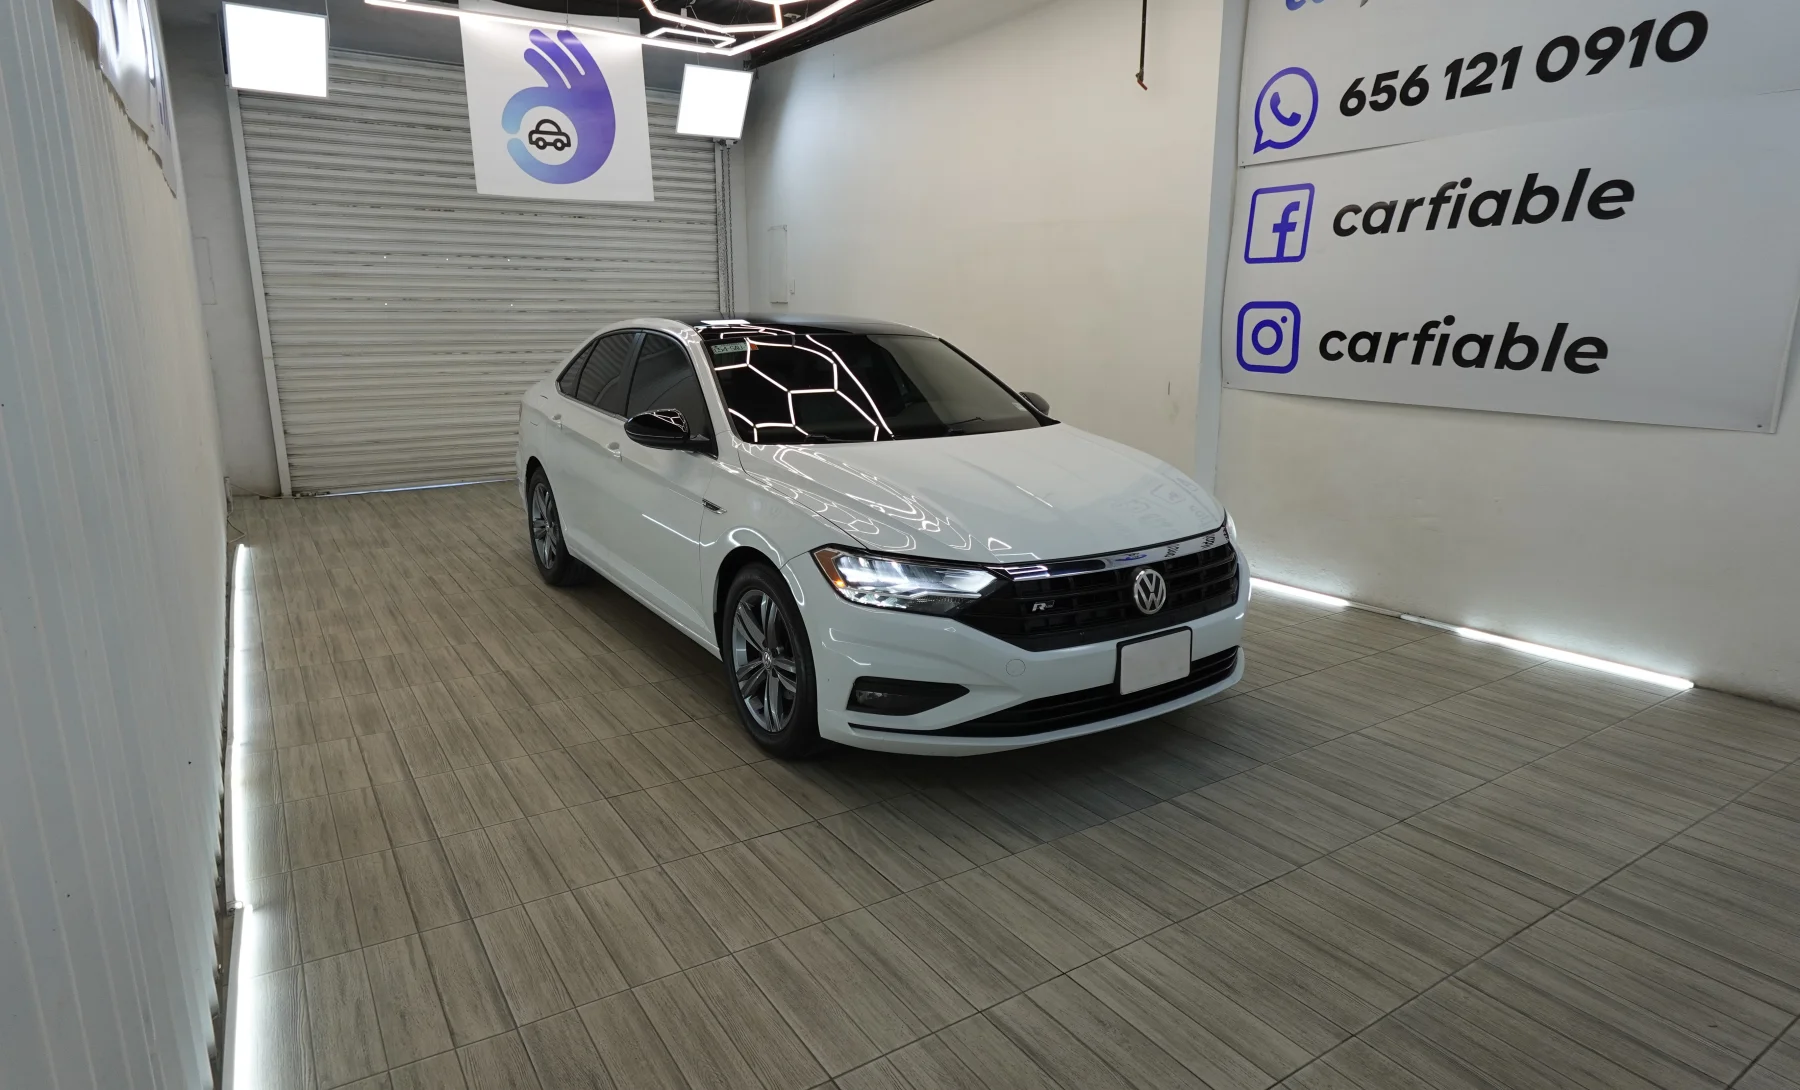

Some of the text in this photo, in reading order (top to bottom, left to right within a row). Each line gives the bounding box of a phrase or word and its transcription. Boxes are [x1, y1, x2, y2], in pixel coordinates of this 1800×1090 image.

[1339, 10, 1709, 117] 656 121 0910
[1332, 167, 1635, 237] carfiable
[1318, 314, 1609, 375] carfiable
